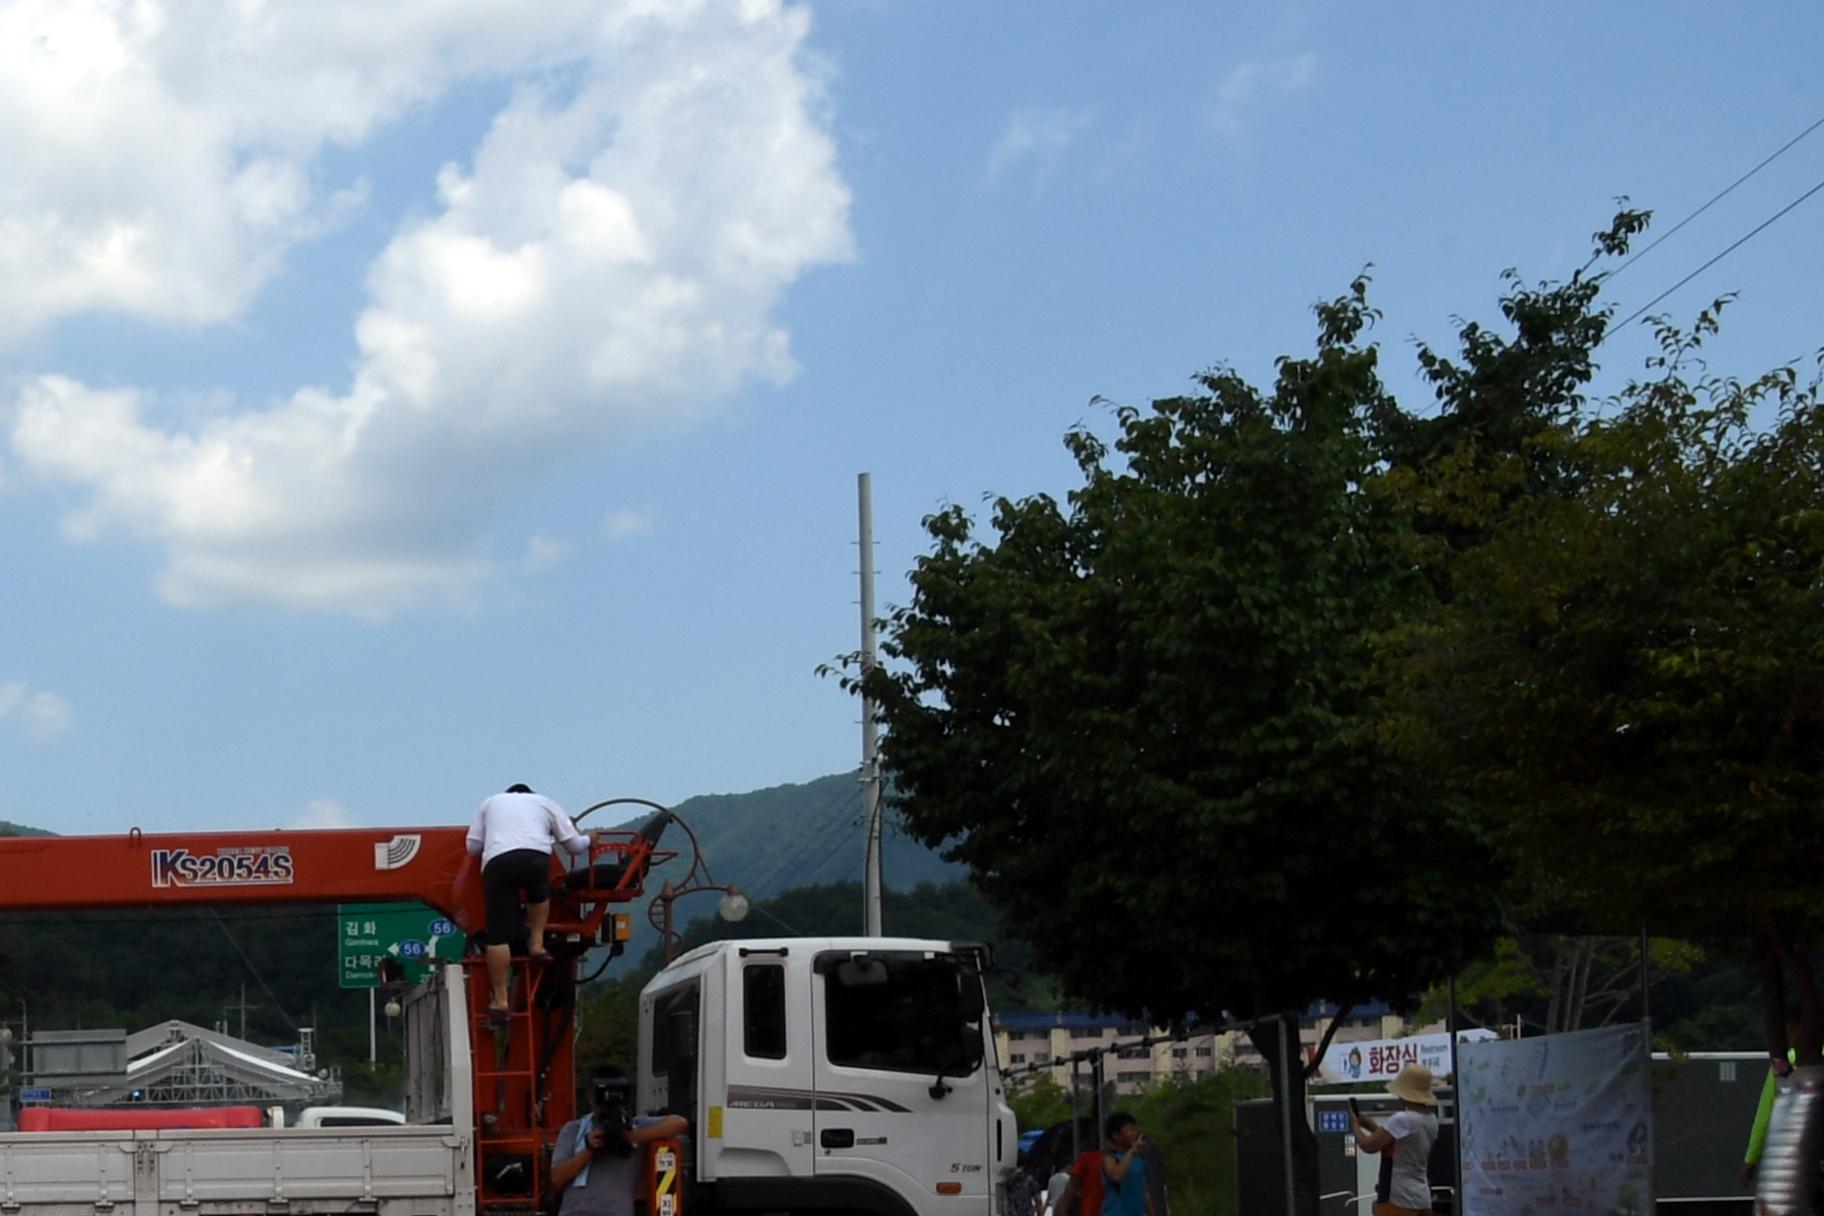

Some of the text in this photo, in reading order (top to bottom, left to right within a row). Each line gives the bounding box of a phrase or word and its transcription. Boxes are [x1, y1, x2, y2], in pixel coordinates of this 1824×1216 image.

[152, 848, 293, 888] KS2054S
[434, 922, 452, 934] 56
[404, 942, 422, 956] 56
[1368, 1043, 1418, 1075] 화장실
[950, 1163, 960, 1173] 5
